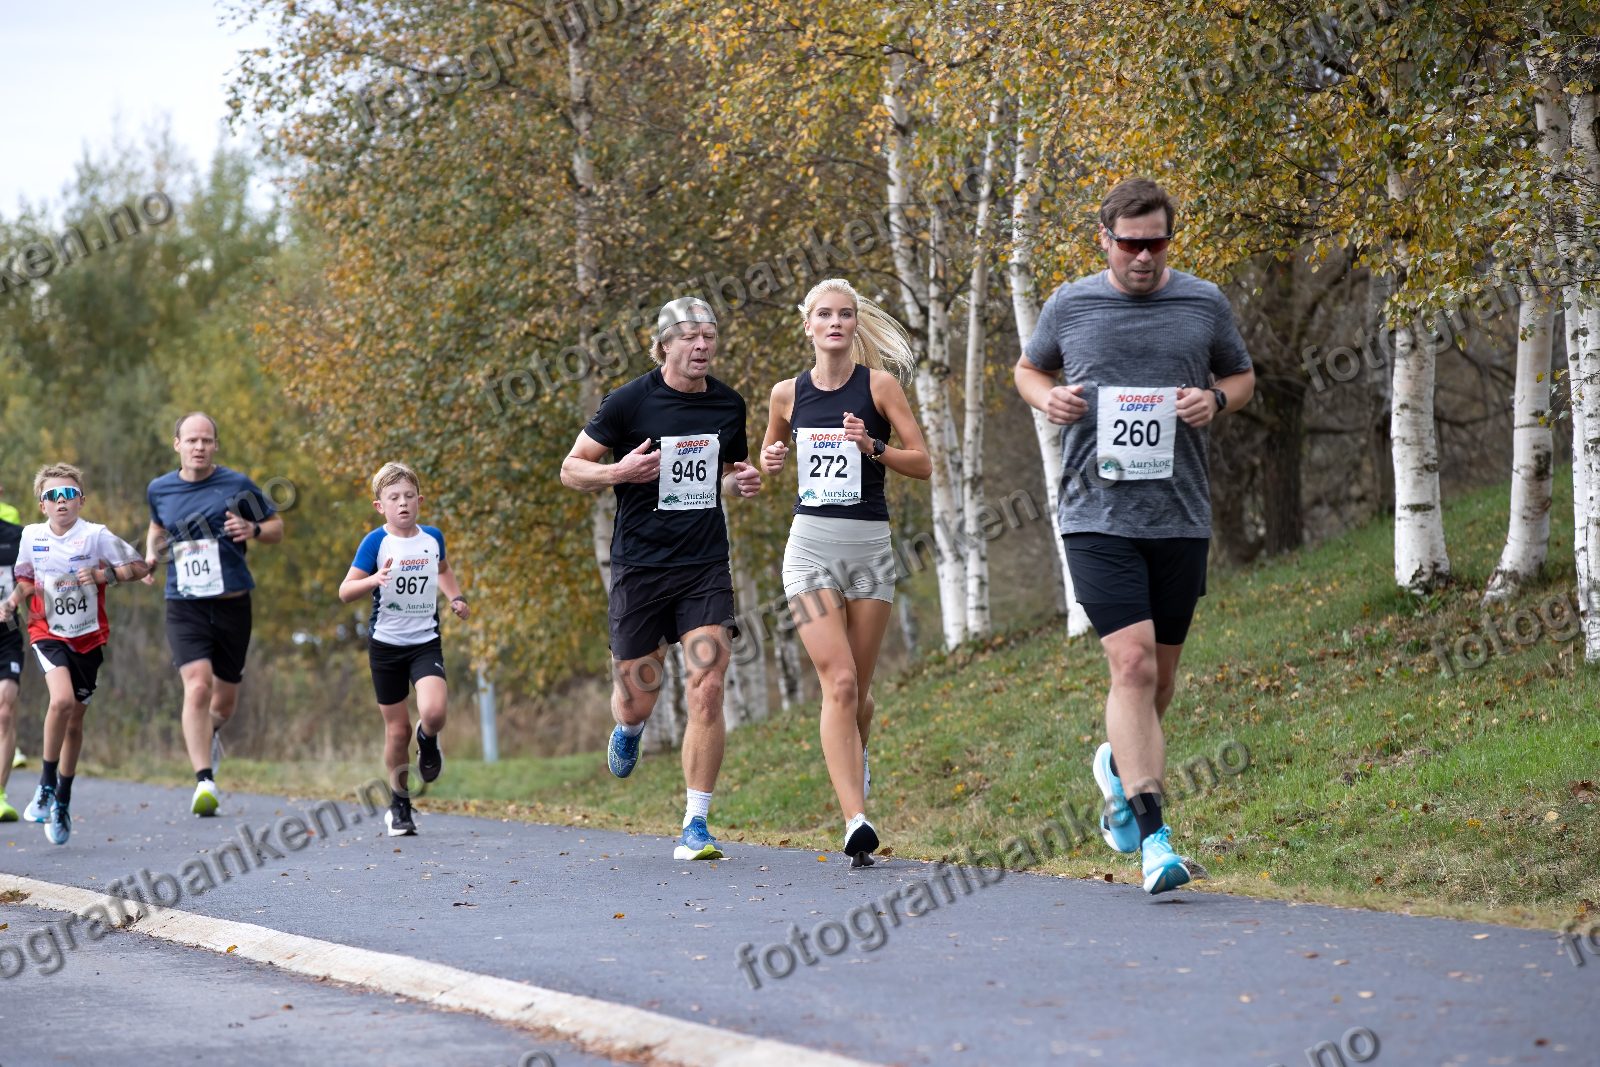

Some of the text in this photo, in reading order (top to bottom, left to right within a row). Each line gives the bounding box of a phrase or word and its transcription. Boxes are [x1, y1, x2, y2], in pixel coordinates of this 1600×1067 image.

[1115, 394, 1164, 403] NORGES
[1120, 403, 1156, 412] LØPET
[810, 433, 848, 441] NORGES
[1112, 419, 1161, 447] 260
[675, 439, 710, 448] NORGES
[813, 441, 842, 449] LØPET
[678, 447, 704, 456] LØPET
[810, 454, 848, 478] 272
[1128, 458, 1171, 469] Aurskog
[672, 459, 707, 483] 946
[684, 491, 715, 501] Aurskog
[821, 488, 859, 499] Aurskog
[399, 558, 429, 566] NORGES
[184, 559, 210, 577] 104
[395, 576, 429, 595] 967
[54, 595, 88, 615] 864
[405, 602, 434, 610] Aurskog
